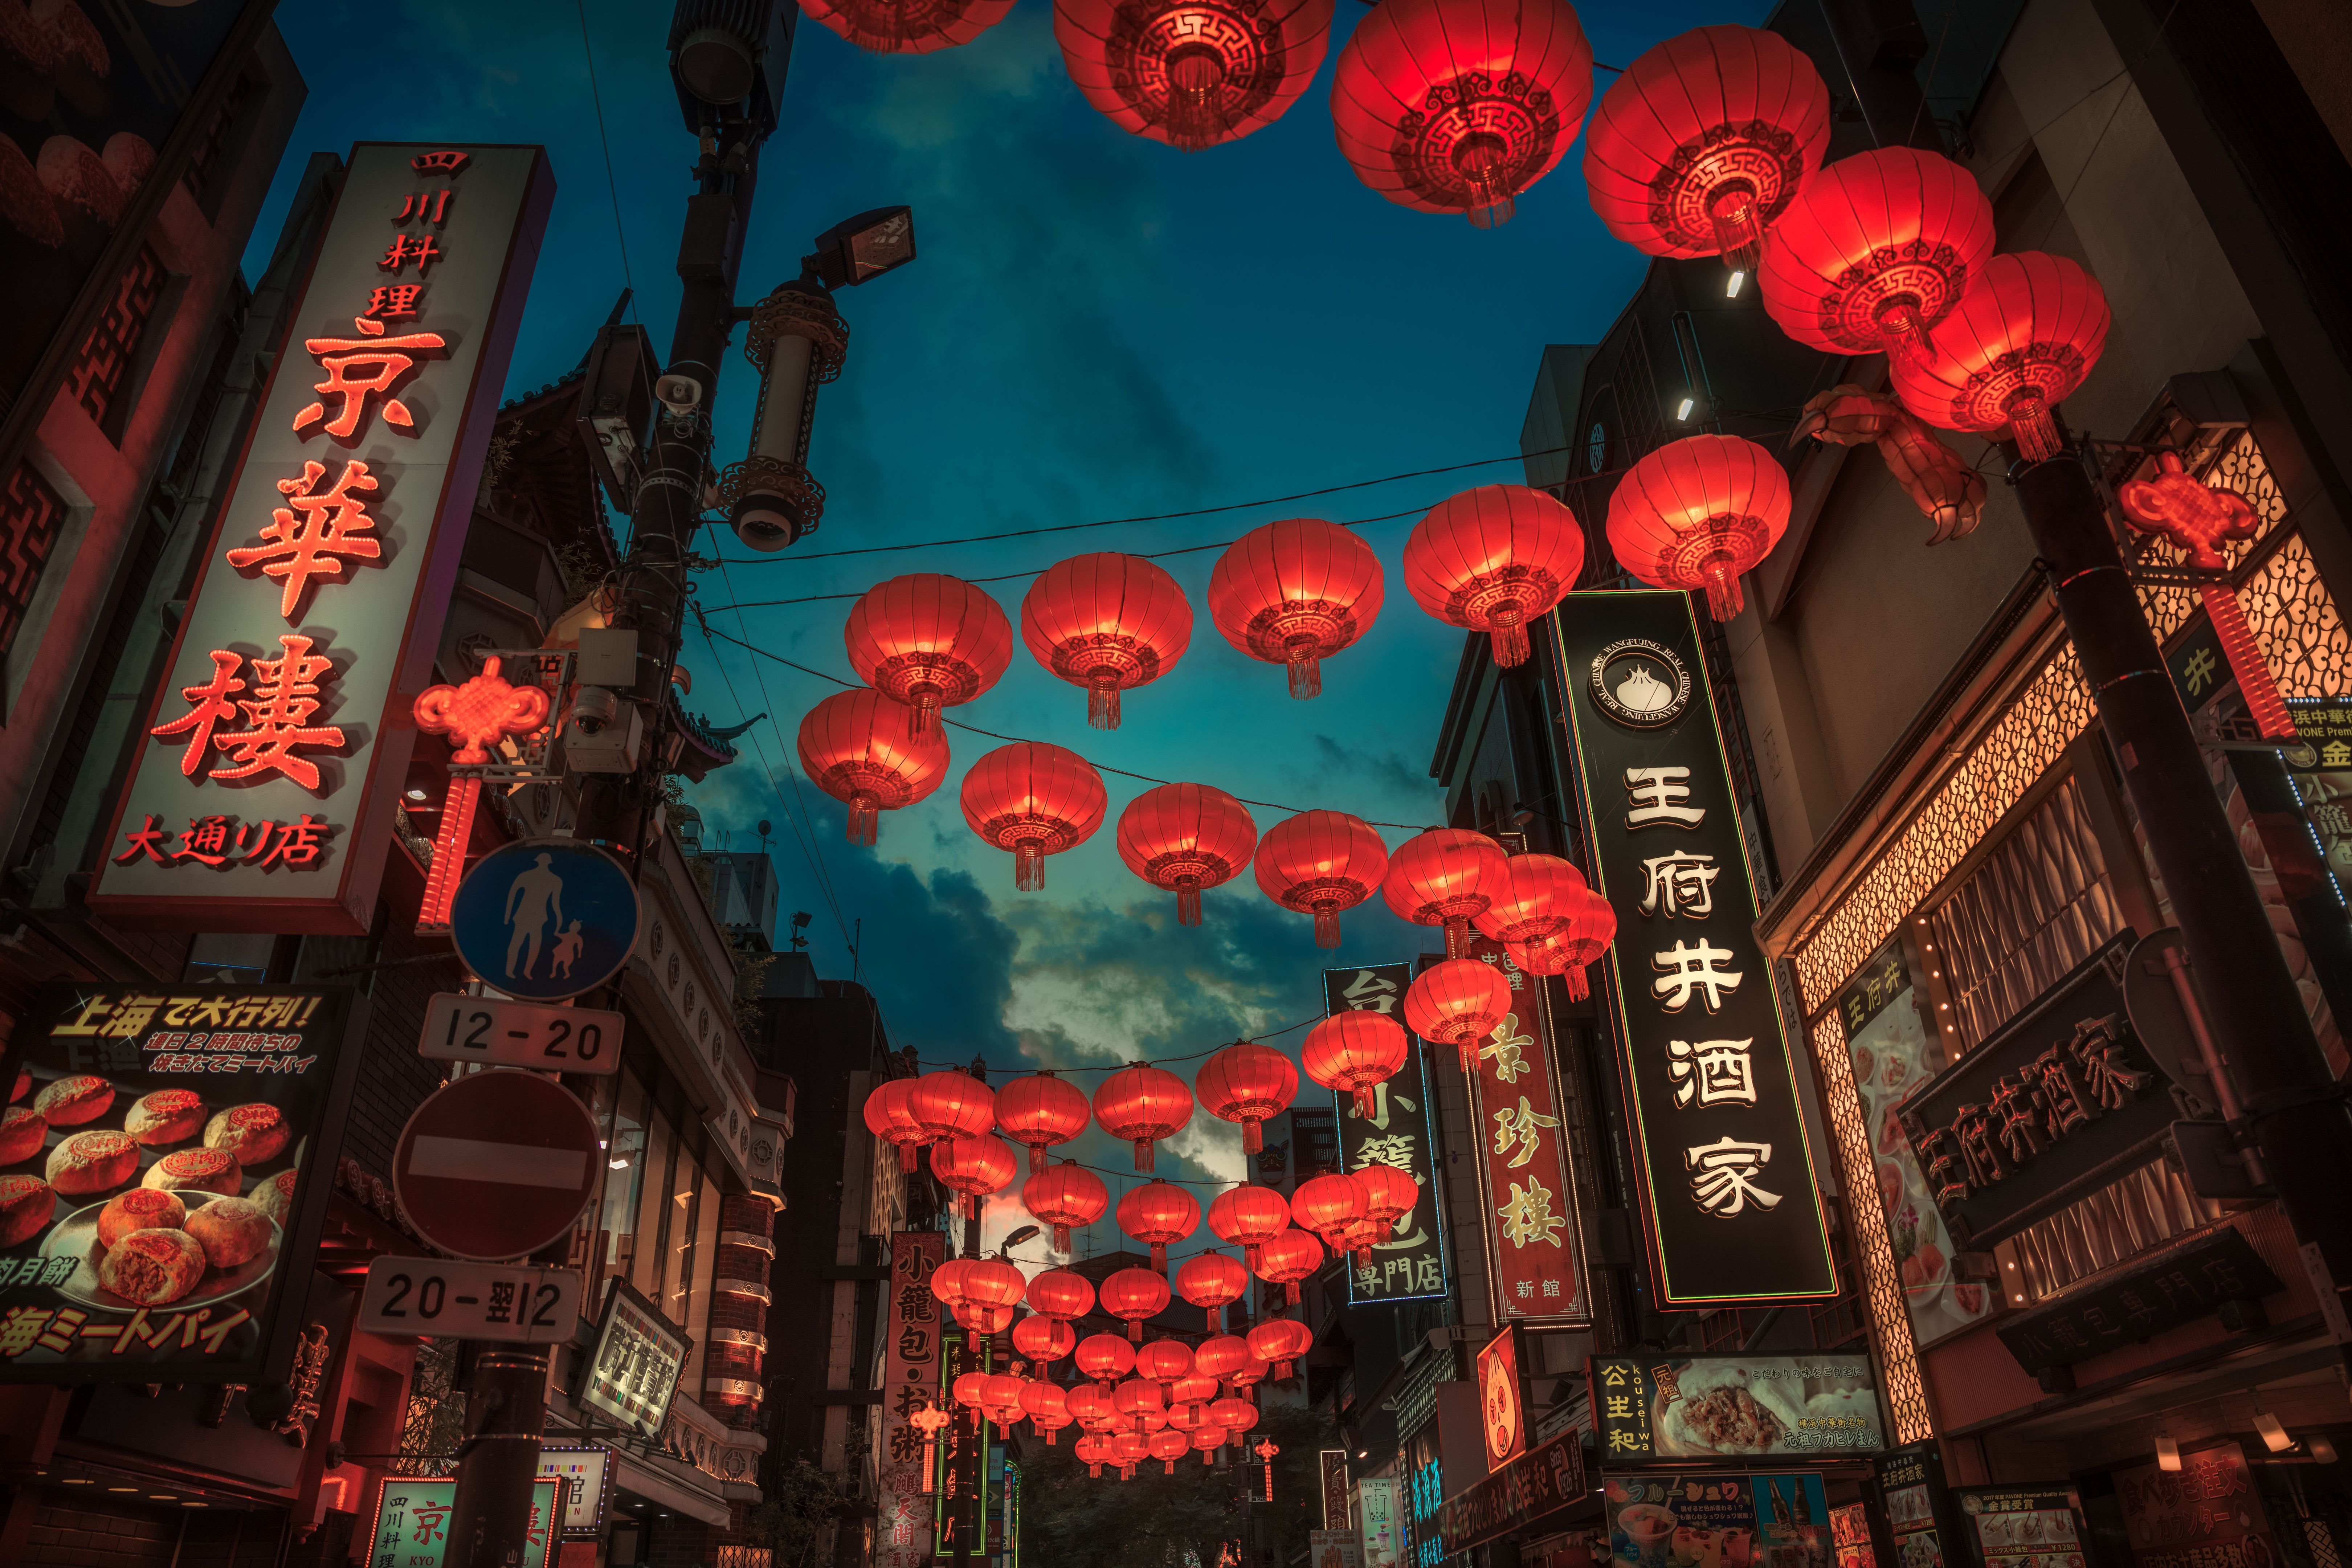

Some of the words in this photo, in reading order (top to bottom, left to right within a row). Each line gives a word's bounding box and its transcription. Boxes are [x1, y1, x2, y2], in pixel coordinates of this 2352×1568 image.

[364, 152, 469, 318] 四川料理
[151, 317, 445, 790] 京華樓
[1604, 639, 1660, 653] WANGFUJING
[1663, 648, 1683, 668] REAL
[1592, 654, 1605, 686] CHINESE
[1598, 690, 1618, 710] REAL
[1678, 671, 1690, 704] CHINESE
[1622, 705, 1680, 720] WANGFUJING
[2296, 727, 2324, 737] VONE
[113, 814, 329, 865] 大通り店
[1626, 767, 1783, 1214] 王府井酒家
[1848, 960, 1900, 1030] 王府井
[149, 1054, 318, 1074] 焼きたてミートパイ
[1917, 1013, 2153, 1213] 王府井酒家
[1353, 1254, 1442, 1297] 専門店
[1516, 1279, 1560, 1299] 新館
[1656, 1369, 1678, 1398] 元祖
[1752, 1366, 1863, 1379] こだわりの味をご自宅に
[1601, 1364, 1640, 1452] 公生和
[1797, 1416, 1867, 1430] 横浜中華街名物
[1783, 1429, 1880, 1448] 元祖フカヒレまん
[1550, 1450, 1562, 1469] Since
[1882, 1464, 1925, 1489] 王府井酒家
[2121, 1455, 2247, 1515] 食べ歩き注文
[1413, 1456, 1443, 1524] 海源酒
[1628, 1482, 1740, 1502] フルーシュワ
[1988, 1499, 2034, 1511] 金賞受賞
[378, 1497, 408, 1568] 四川料理
[2157, 1506, 2230, 1540] カウンター
[887, 1551, 920, 1568] 酒家
[1988, 1545, 2029, 1554] ミックス小籠包
